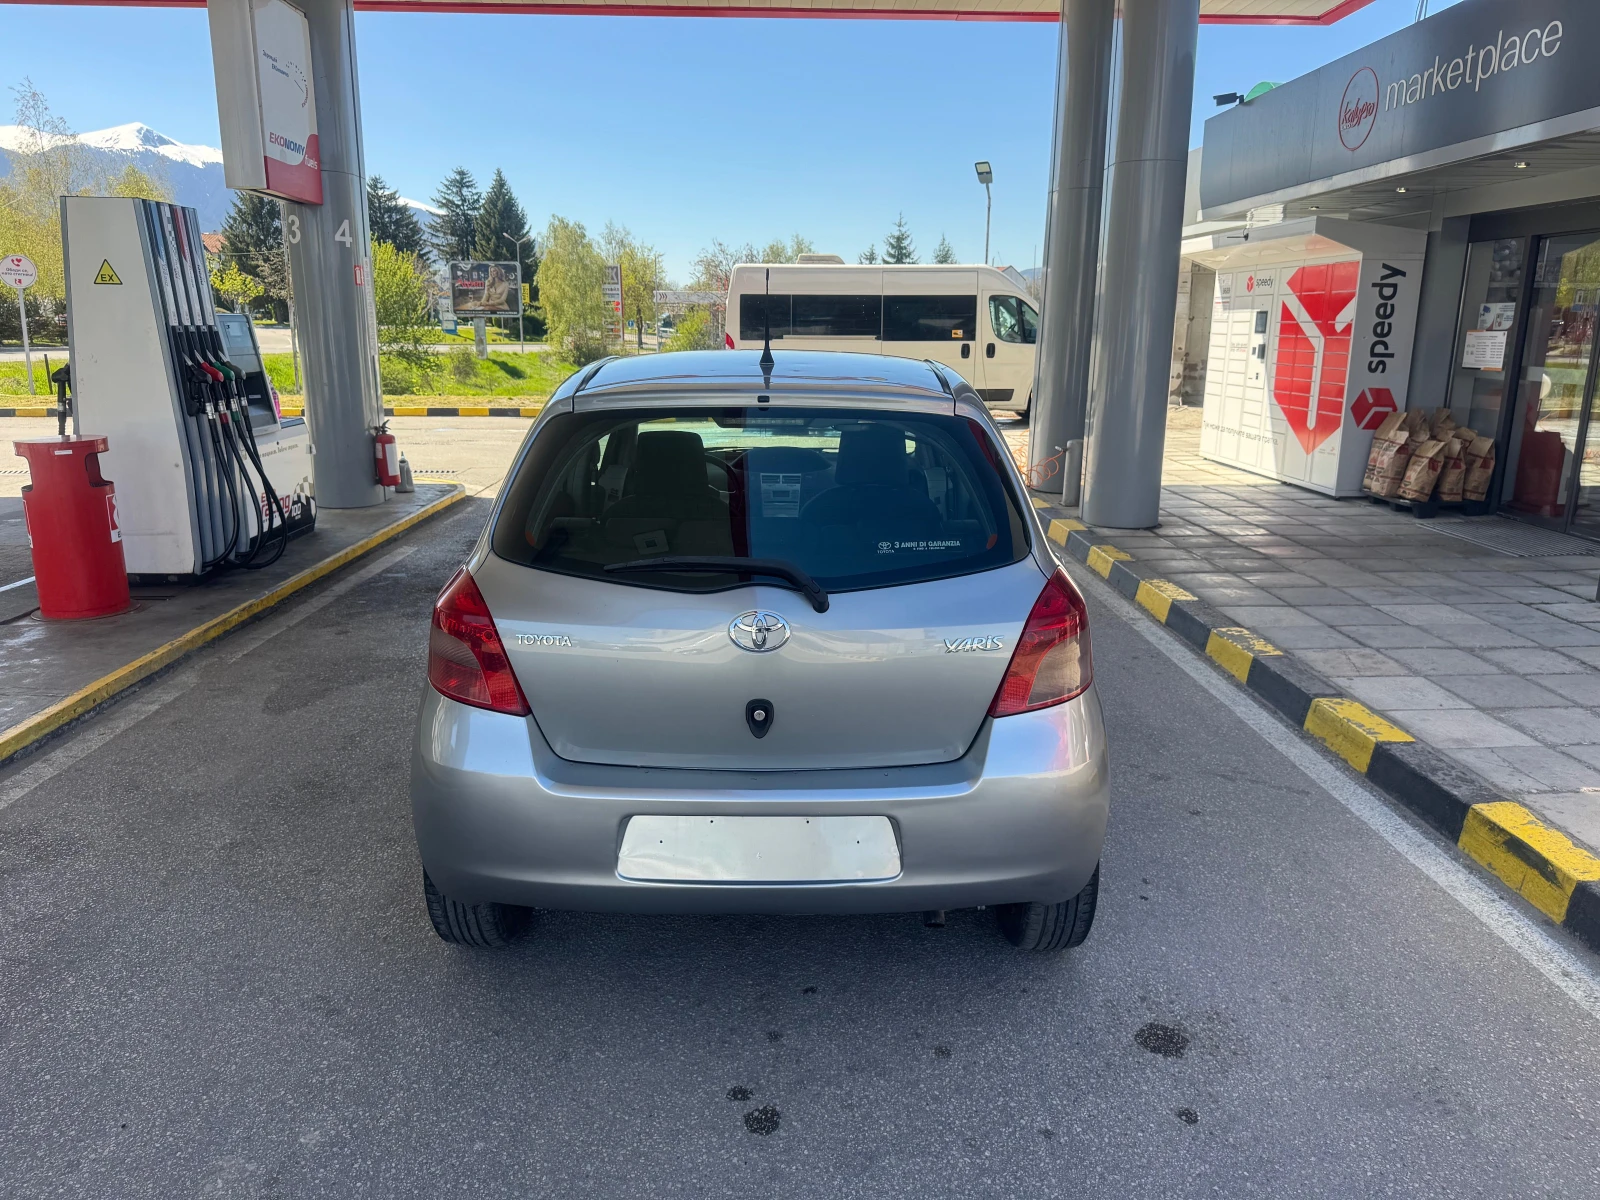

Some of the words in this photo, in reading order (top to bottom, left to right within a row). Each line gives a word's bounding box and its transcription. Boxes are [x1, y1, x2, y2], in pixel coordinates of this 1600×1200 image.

[1385, 20, 1563, 112] marketplace
[269, 131, 305, 156] EKONOMY
[304, 154, 318, 170] fuels
[287, 215, 301, 244] 3
[334, 219, 353, 248] 4
[100, 273, 115, 283] EX
[1256, 275, 1274, 288] speedy
[1368, 262, 1407, 374] speedy
[515, 634, 572, 647] TOYOTA
